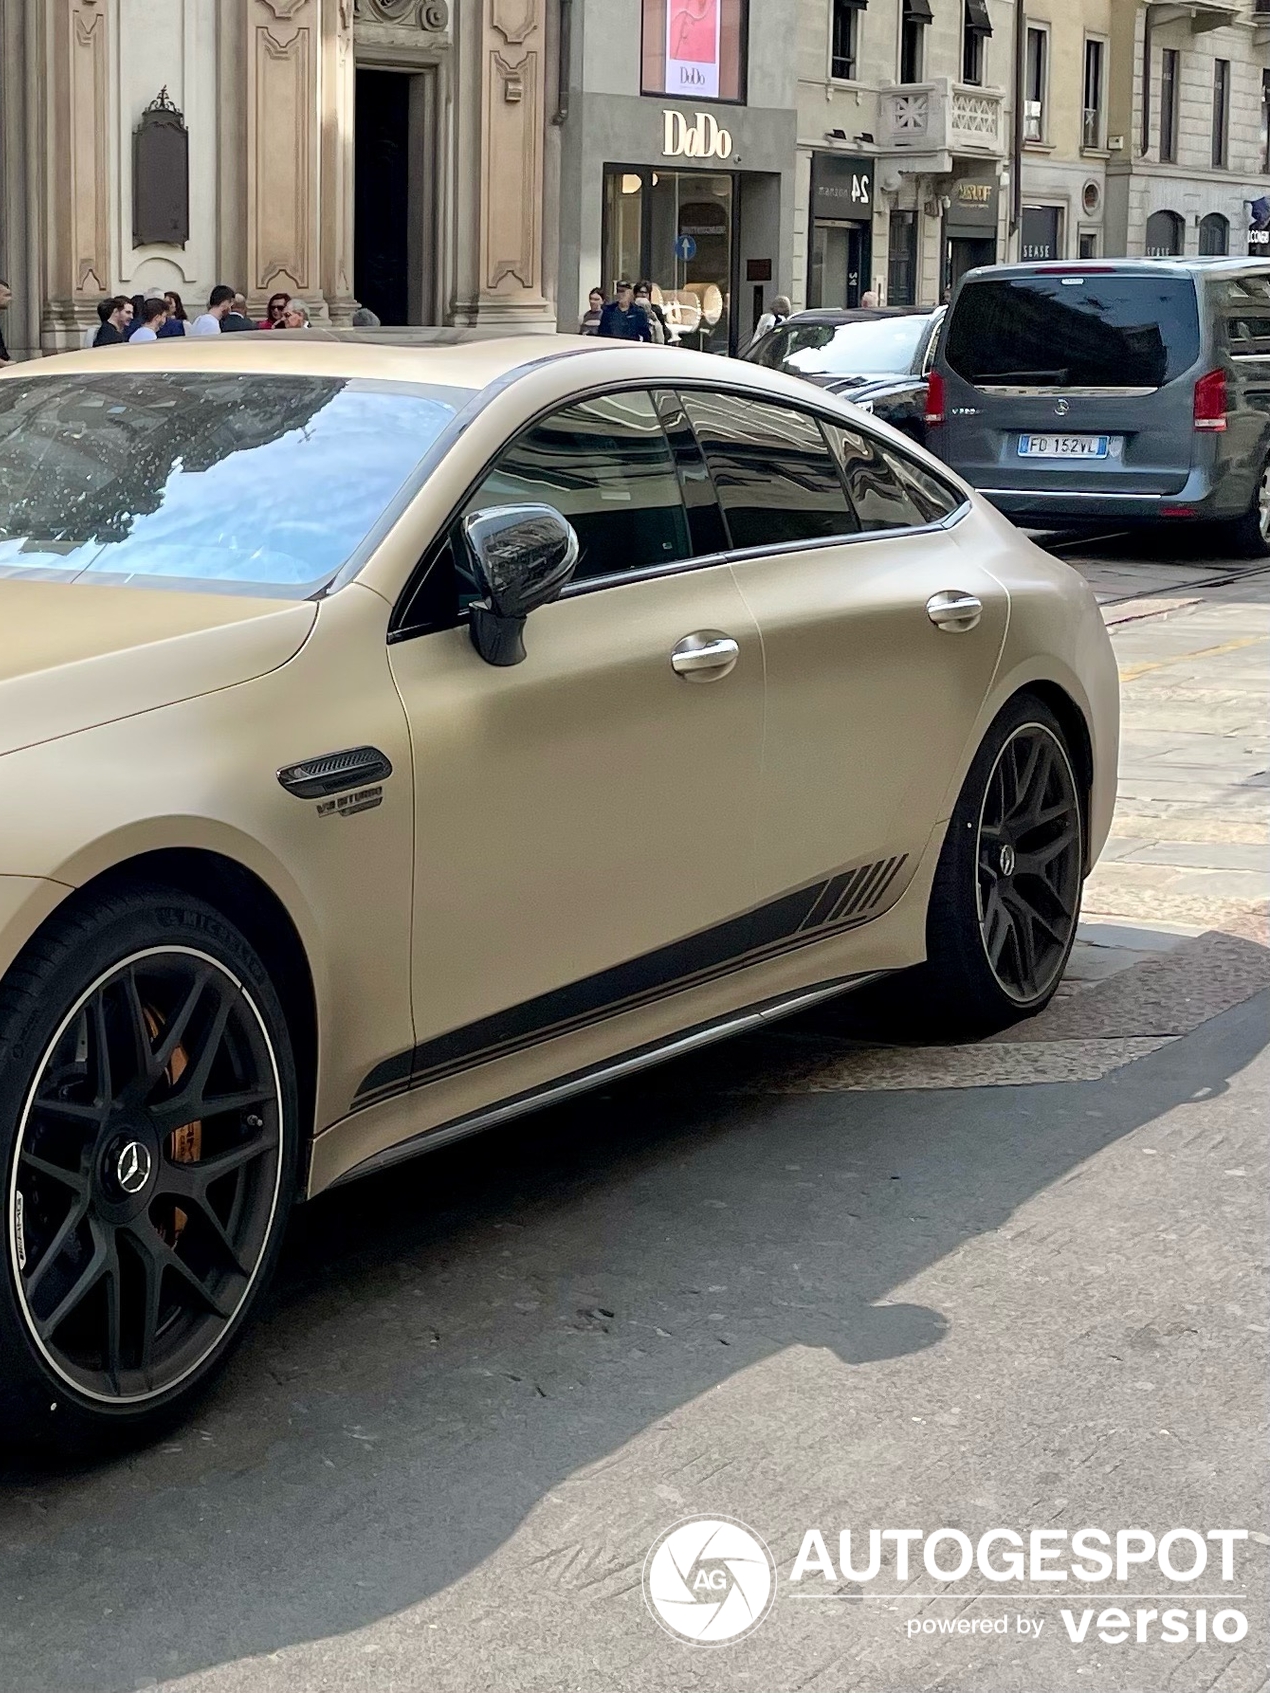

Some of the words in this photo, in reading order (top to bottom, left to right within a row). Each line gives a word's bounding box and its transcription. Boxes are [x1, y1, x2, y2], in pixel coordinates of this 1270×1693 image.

[680, 66, 705, 85] DoDo
[662, 110, 732, 158] DoDo
[1023, 245, 1049, 257] SEASE
